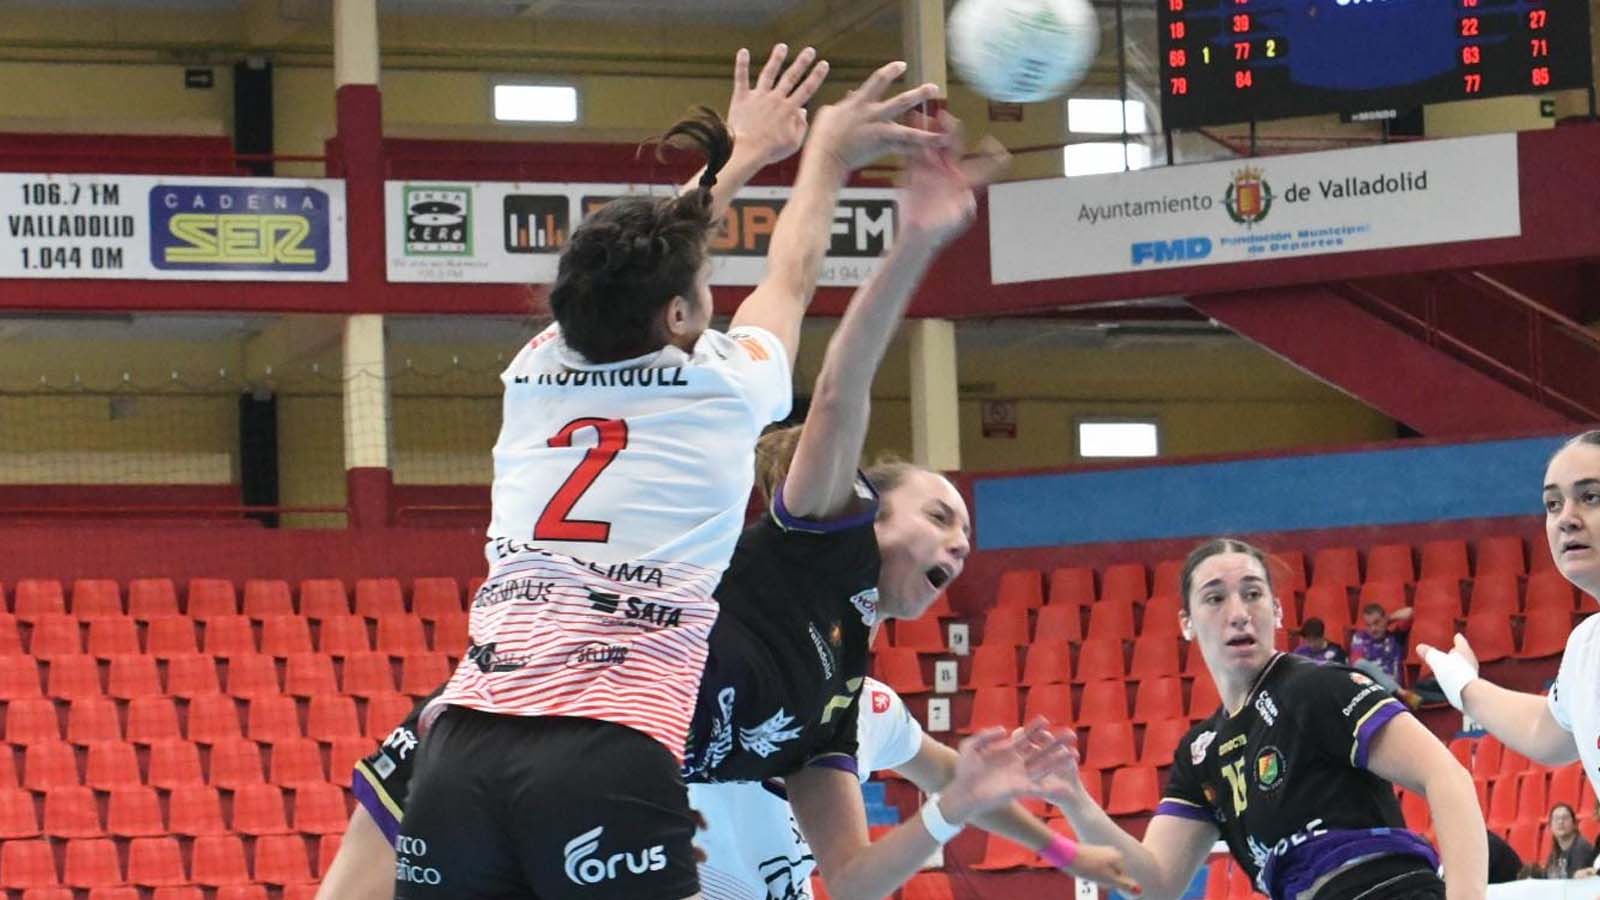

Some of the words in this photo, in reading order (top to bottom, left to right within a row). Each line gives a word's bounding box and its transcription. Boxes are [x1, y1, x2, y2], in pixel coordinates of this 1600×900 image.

[1462, 18, 1479, 36] 22
[1530, 10, 1547, 29] 27
[1202, 46, 1210, 64] 1
[1234, 42, 1250, 60] 77
[1266, 39, 1276, 57] 2
[1530, 39, 1548, 57] 71
[1464, 75, 1481, 92] 77
[22, 183, 81, 205] 106.7
[165, 194, 314, 209] CADENA
[1077, 194, 1213, 224] Ayuntamiento
[1284, 183, 1311, 203] de
[1319, 170, 1428, 199] Valladolid
[8, 215, 134, 237] VALLADOLID
[165, 213, 317, 263] SER
[22, 247, 82, 269] 1.044
[1130, 236, 1213, 265] FMD
[533, 417, 628, 543] 2
[624, 596, 683, 628] SATA
